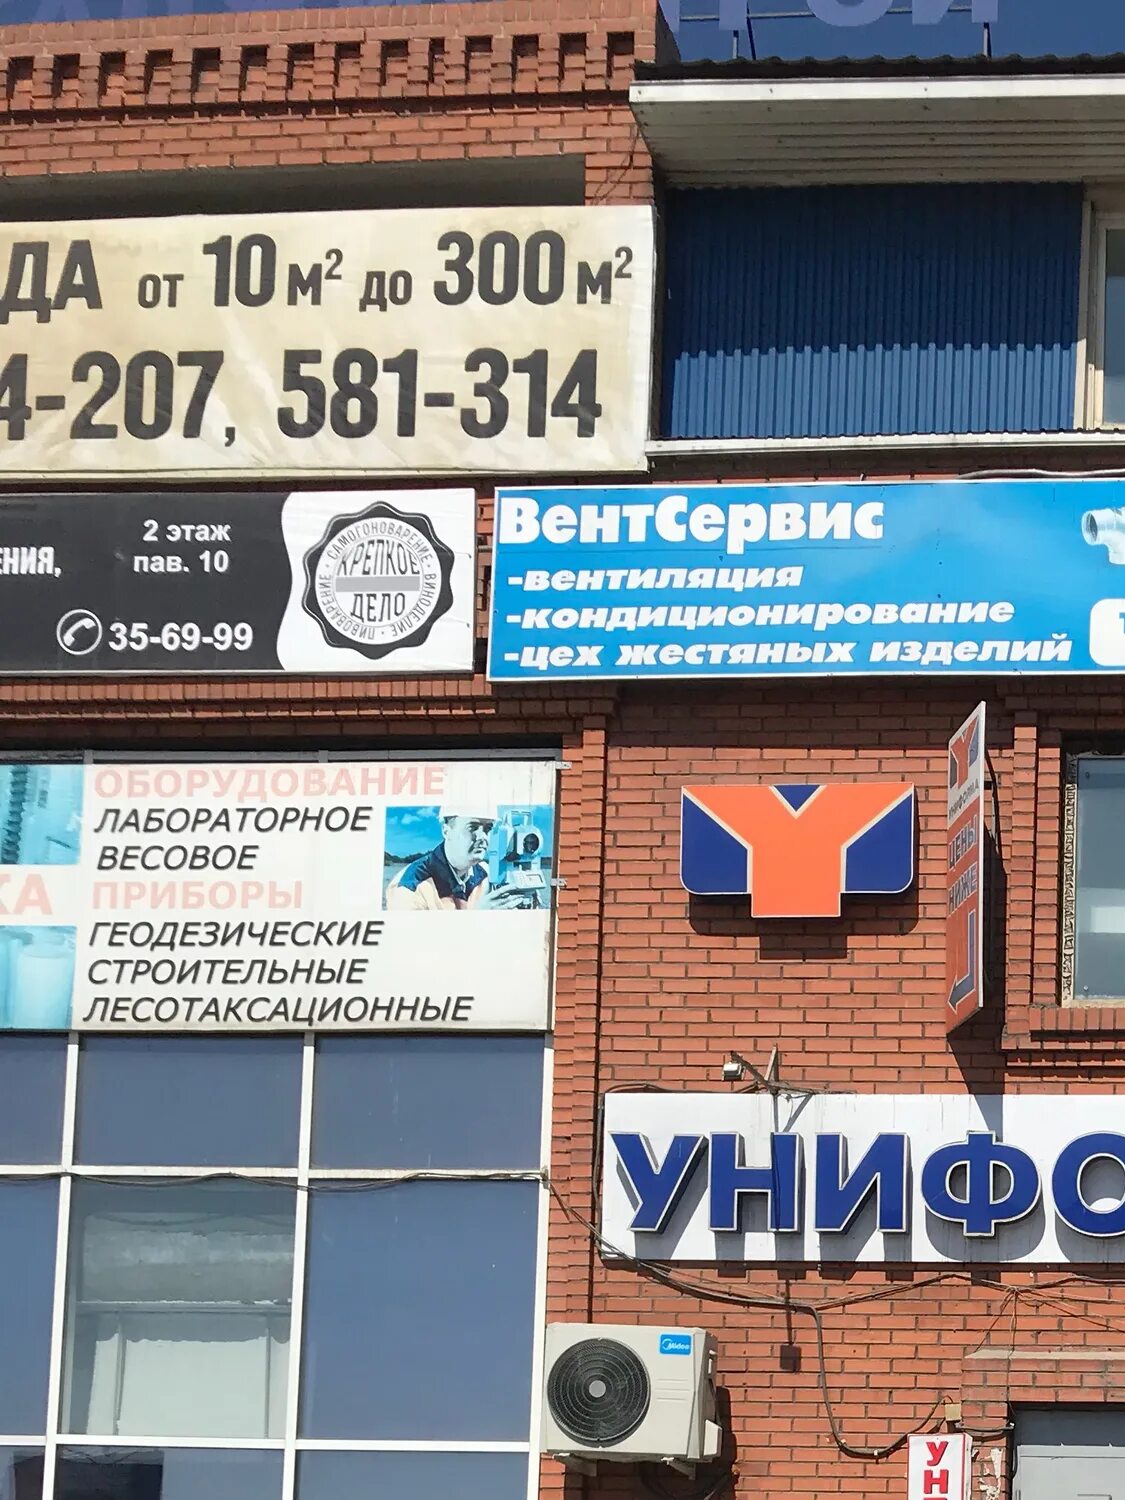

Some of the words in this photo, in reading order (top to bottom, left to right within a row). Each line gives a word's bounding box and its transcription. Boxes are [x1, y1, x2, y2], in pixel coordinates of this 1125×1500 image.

[138, 274, 184, 308] от
[202, 233, 277, 307] 10
[359, 269, 412, 312] до
[433, 230, 565, 306] 300
[277, 349, 602, 439] 581-314
[142, 521, 159, 541] 2
[166, 522, 231, 543] этаж
[499, 495, 884, 555] ВентСервис
[327, 521, 433, 563] САМОГОНОВАРЕНИЕ
[336, 539, 420, 576] КРЕПКОЕ
[0, 546, 62, 578] НИЯ,
[133, 553, 190, 574] пав.
[198, 552, 229, 573] 10
[508, 565, 805, 592] -вентиляция
[350, 592, 406, 623] ДЕЛО
[506, 601, 1015, 632] -кондиционирование
[108, 623, 253, 652] 35-69-99
[504, 645, 604, 671] -цех
[615, 642, 857, 666] жестяных
[869, 632, 1073, 666] изделий
[94, 767, 444, 802] ОБОРУДОВАНИЕ
[94, 806, 372, 833] ЛАБОРАТОРНОЕ
[97, 845, 258, 872] ВЕСОВОЕ
[949, 815, 977, 871] ЦЕНЫ
[92, 881, 303, 910] ПРИБОРЫ
[88, 920, 384, 949] ГЕОДЕЗИЧЕСКИЕ
[87, 959, 368, 985] СТРОИТЕЛЬНЫЕ
[82, 996, 474, 1026] ЛЕСОТАКСАЦИОННЫЕ
